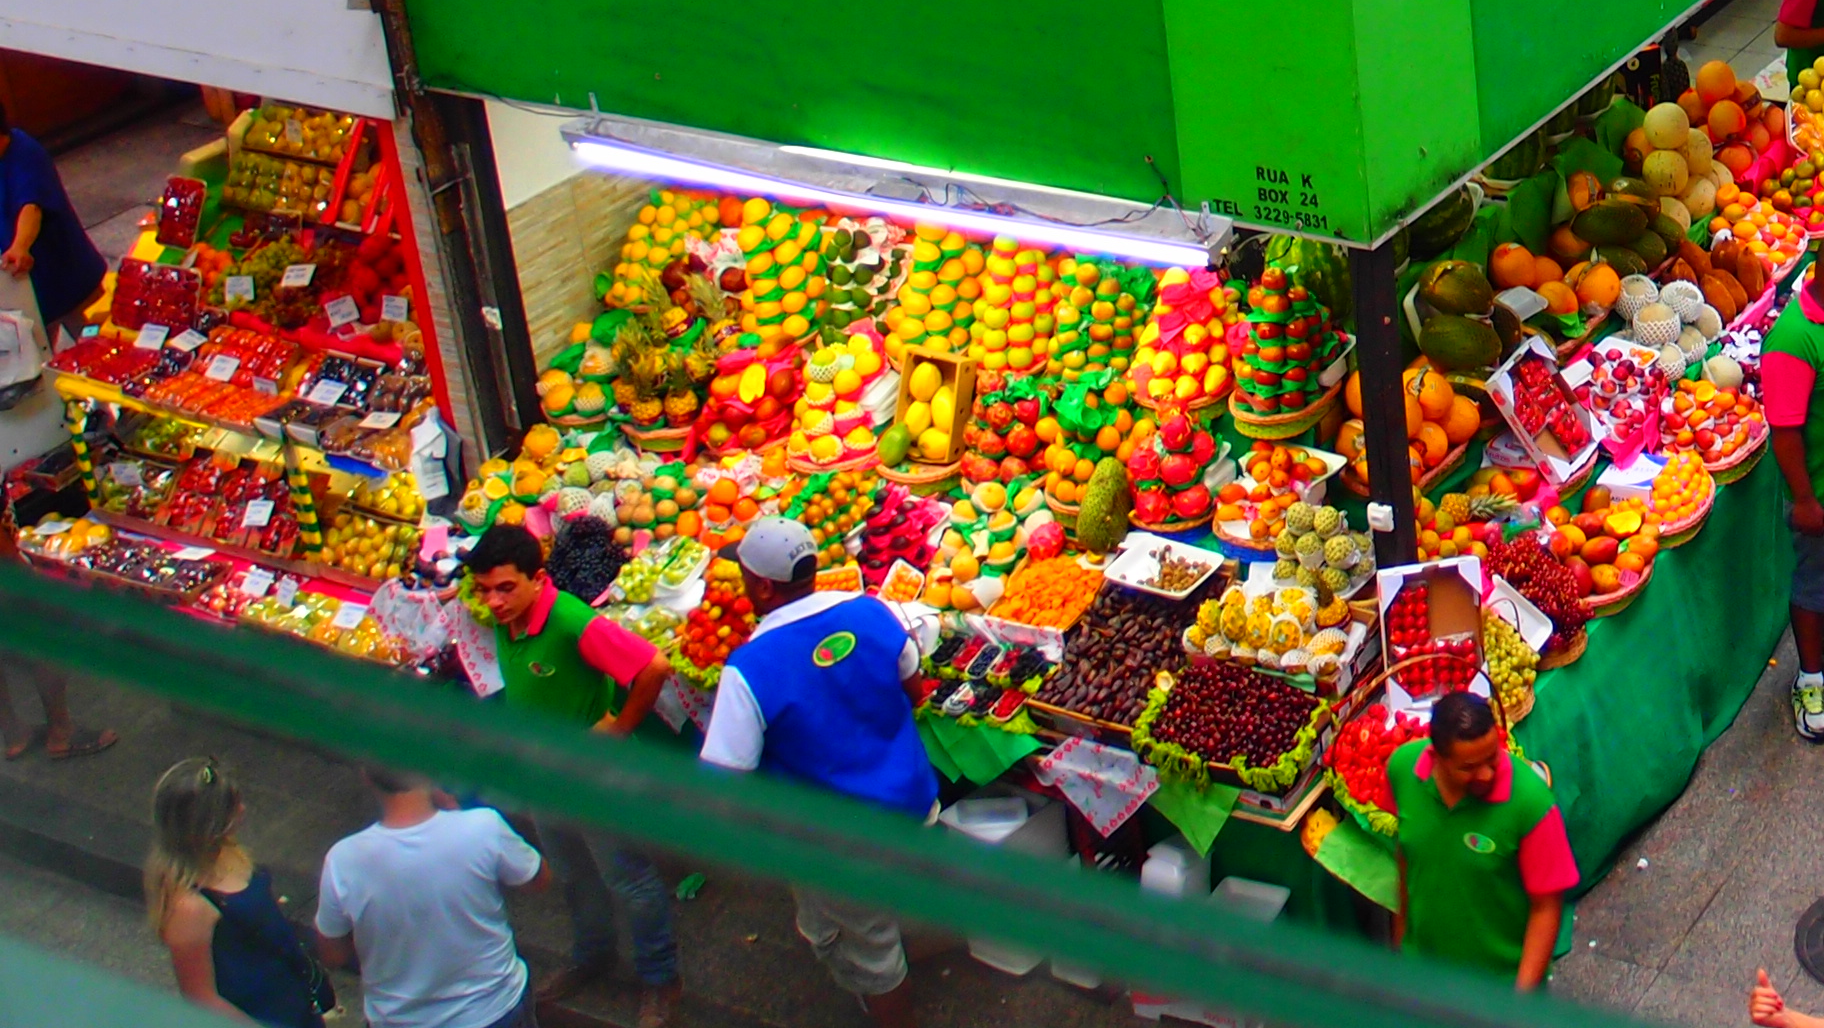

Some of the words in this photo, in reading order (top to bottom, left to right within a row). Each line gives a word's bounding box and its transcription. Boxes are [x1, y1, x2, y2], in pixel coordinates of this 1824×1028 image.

[1256, 166, 1289, 185] RUA
[1301, 174, 1313, 189] K
[1258, 187, 1289, 205] BOX
[1300, 192, 1318, 208] 24
[1213, 198, 1243, 216] TEL
[1254, 205, 1328, 230] 3229-5831
